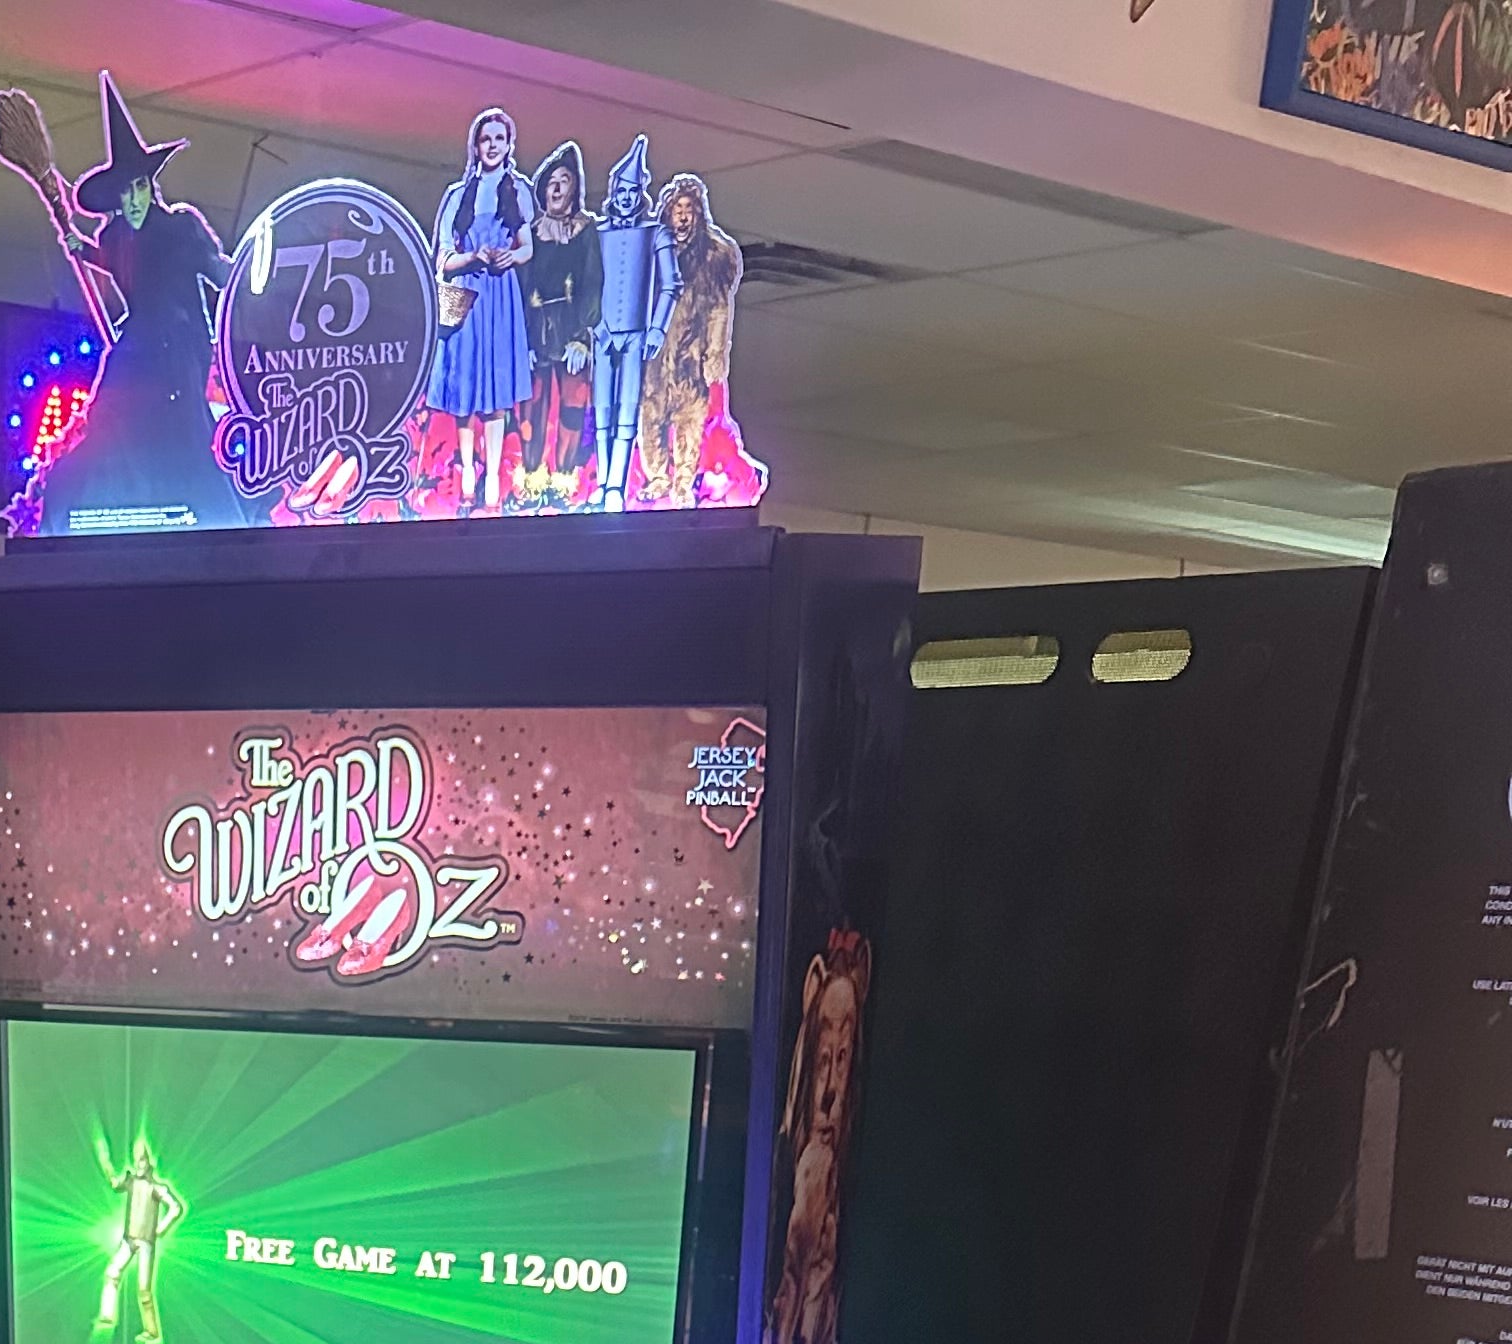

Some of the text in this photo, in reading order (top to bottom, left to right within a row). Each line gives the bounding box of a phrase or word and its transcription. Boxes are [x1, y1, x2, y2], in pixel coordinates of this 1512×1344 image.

[272, 238, 395, 342] 75th
[244, 341, 408, 373] ANNIVERSARY
[266, 382, 294, 408] The
[225, 378, 361, 483] WIZARD
[239, 738, 293, 786] The
[688, 746, 756, 768] JERSEY
[686, 790, 752, 806] PINBALL
[694, 769, 747, 791] JACK
[164, 737, 424, 920] WIZARD
[300, 860, 338, 914] of
[480, 1252, 627, 1295] 112,000
